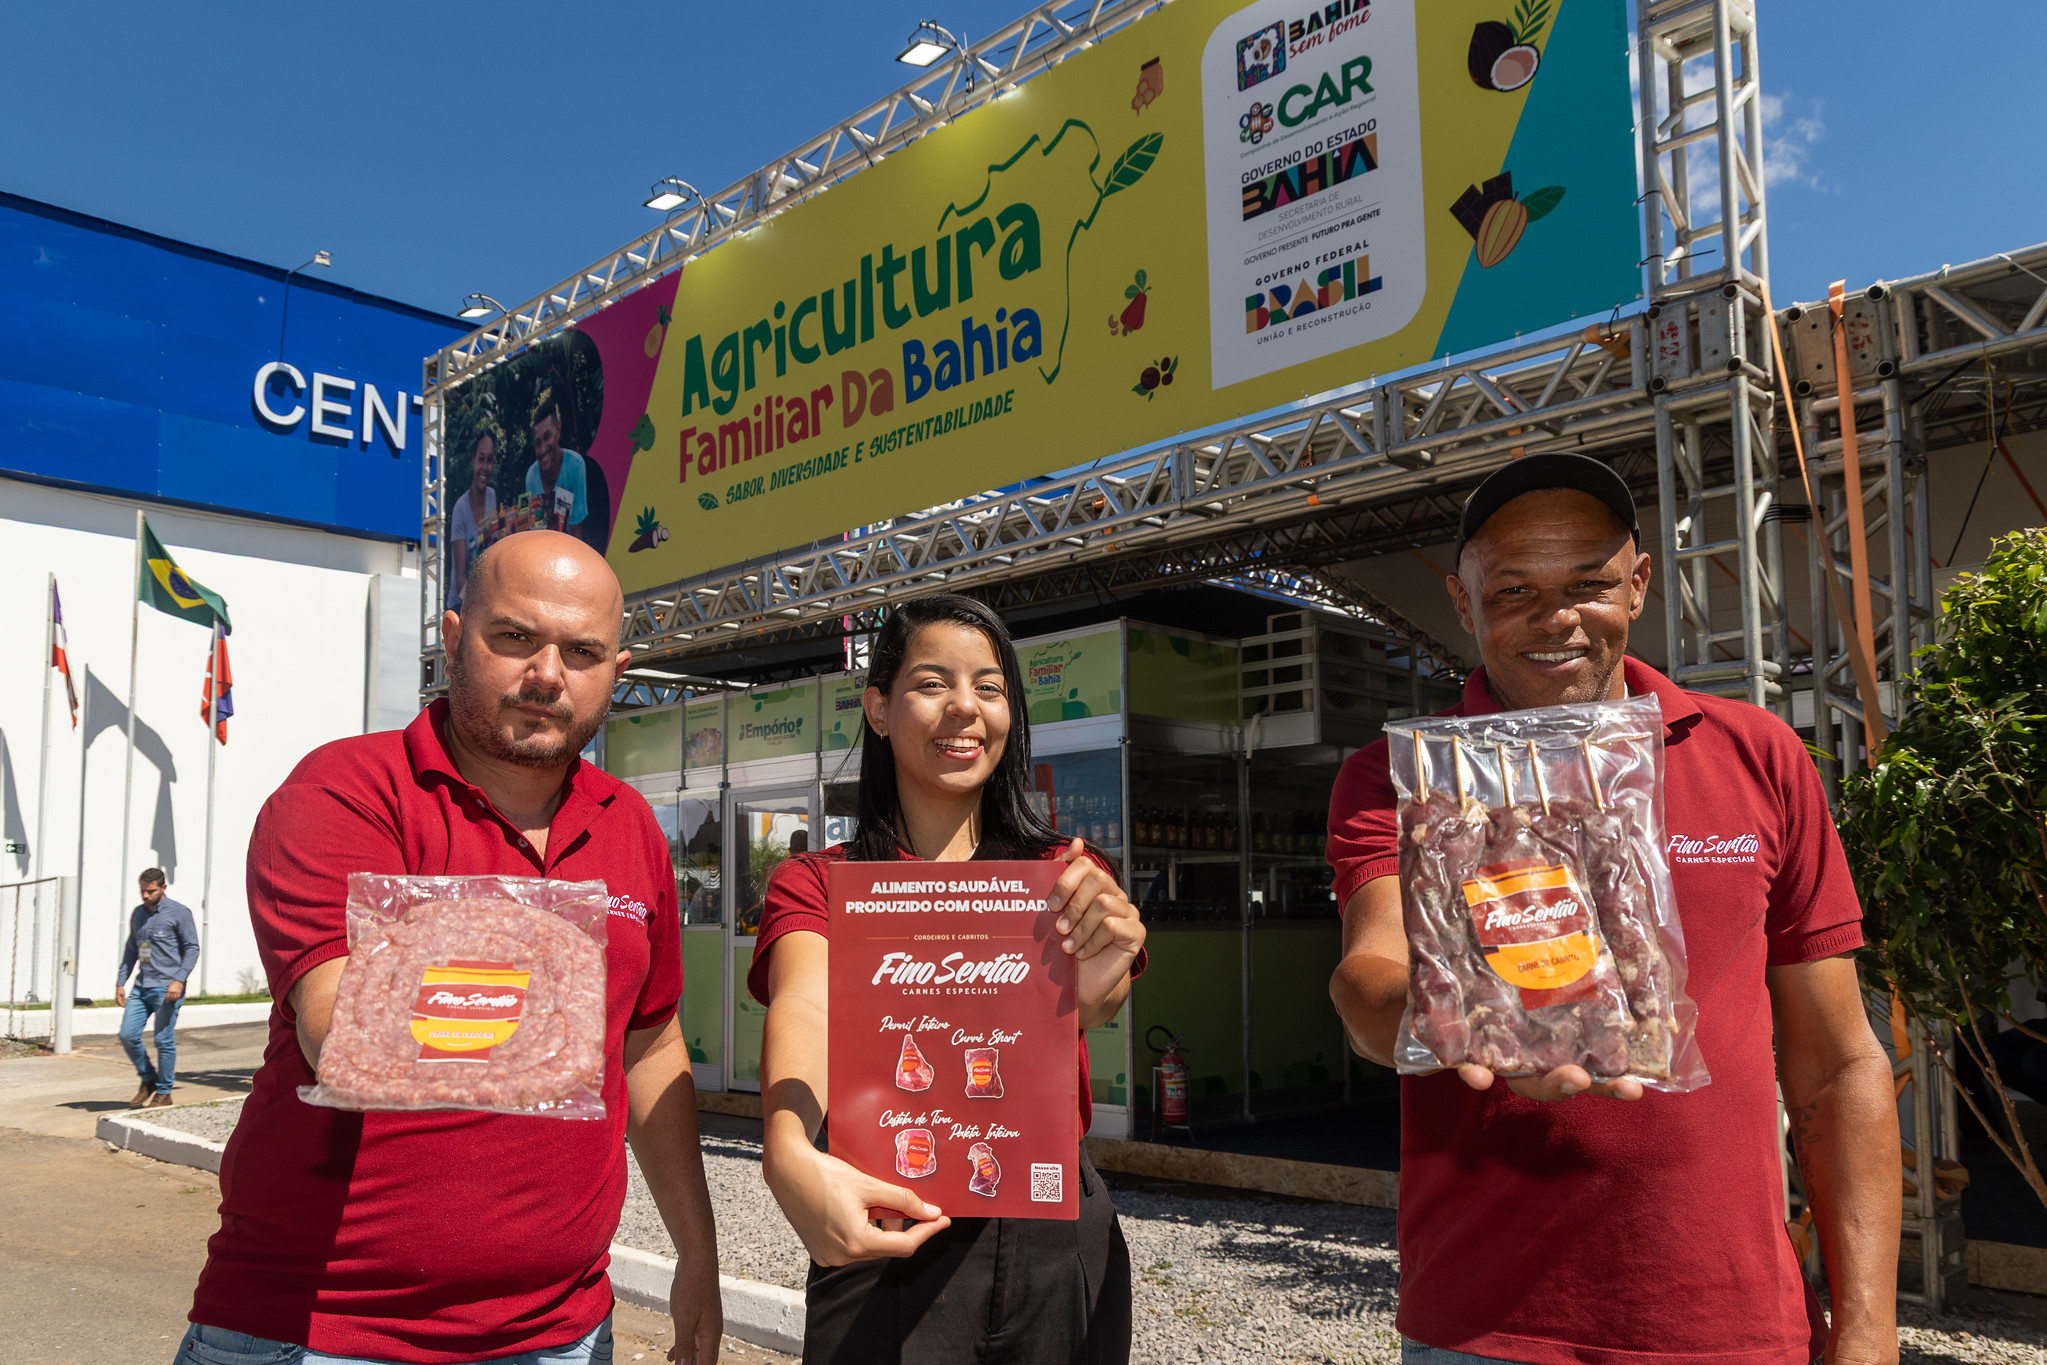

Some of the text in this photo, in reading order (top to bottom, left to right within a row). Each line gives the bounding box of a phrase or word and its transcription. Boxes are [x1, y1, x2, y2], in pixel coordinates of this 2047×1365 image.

[1289, 9, 1371, 59] sem fome
[1277, 55, 1375, 128] CAR
[1241, 118, 1377, 184] GOVERNO DO ESTADO
[1242, 132, 1378, 222] BAHIA
[1258, 194, 1363, 241] DESENVOLVIMENTO RURAL
[1278, 191, 1340, 221] SECRETARIA DE
[1244, 208, 1381, 265] GOVERNO PRESENTE FUTURO PRA GENTE
[1255, 239, 1370, 287] GOVERNO FEDERAL
[681, 202, 1042, 417] Agricultura
[1245, 254, 1382, 334] BRASIL
[1257, 302, 1372, 345] UNIÃO E RECONSTRUÇÃO
[254, 361, 424, 449] CEN
[679, 307, 1042, 484] Familiar Da Bahia
[725, 389, 1015, 506] SABOR, DIVERSIDADE E SUSTENTABILIDADE
[1029, 664, 1063, 677] Familiar
[1038, 674, 1061, 686] Bahia
[1667, 834, 1759, 854] Fino Sertão
[871, 876, 1030, 895] ALIMENTO SAUDÁVEL,
[845, 899, 1050, 914] PRODUZIDO COM QUALIDAD
[1484, 898, 1578, 931] Fino Sertão
[871, 952, 1030, 986] Fino Sertão
[1517, 961, 1540, 973] CARNE
[427, 991, 518, 1007] Fino Sertão
[946, 987, 999, 995] ESPECIAIS
[879, 1015, 950, 1032] Pernil Inteiro
[951, 1028, 1023, 1046] Carré Short
[879, 1109, 953, 1127] Costela de Tira
[949, 1123, 1020, 1141] Paleta Inteira
